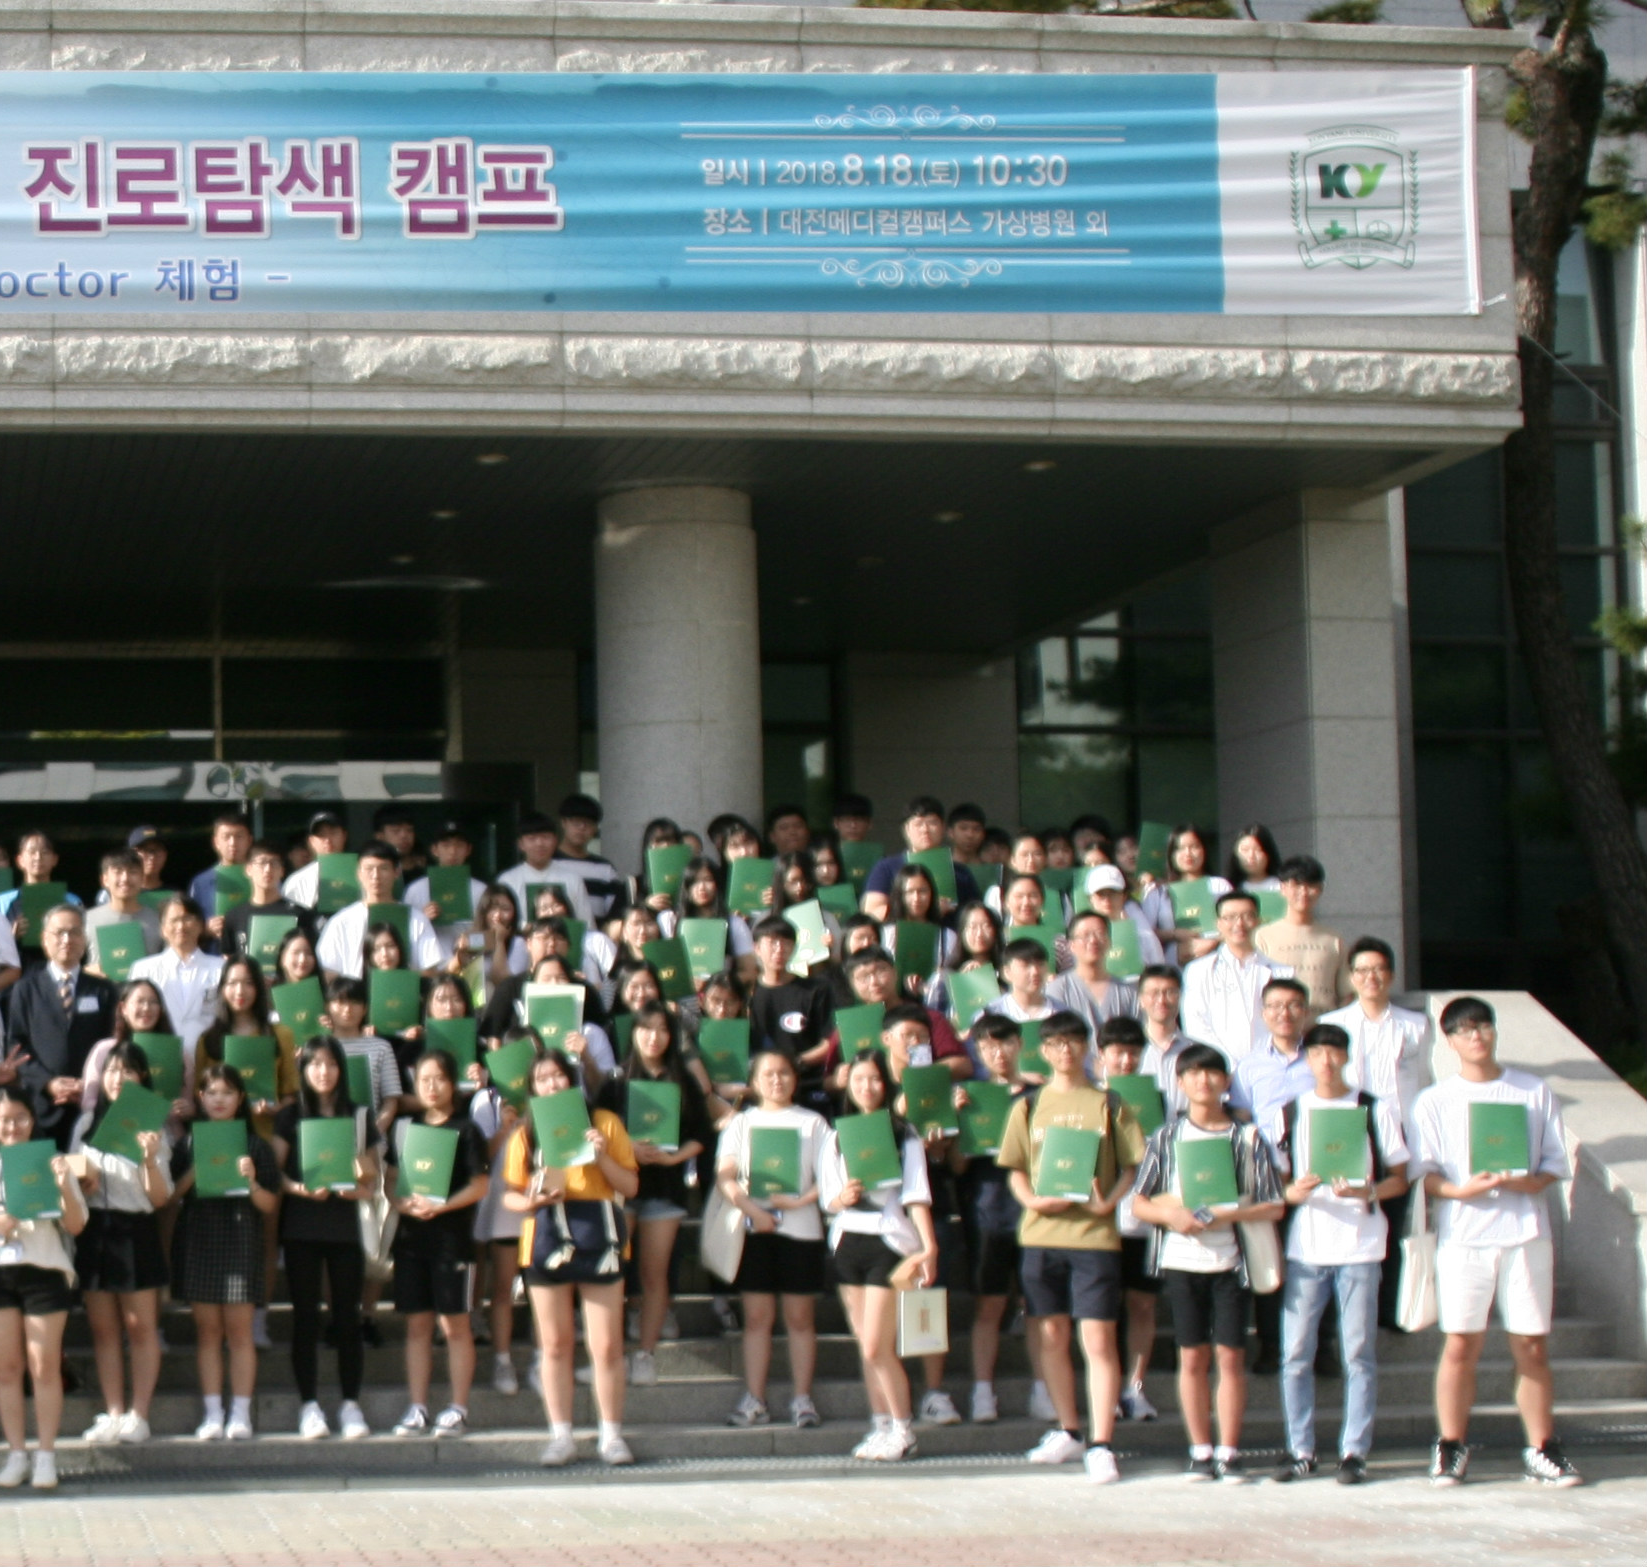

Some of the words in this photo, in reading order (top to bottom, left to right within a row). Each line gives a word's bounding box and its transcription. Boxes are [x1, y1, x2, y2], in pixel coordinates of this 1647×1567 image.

[24, 141, 354, 235] 진로탐색
[391, 140, 562, 233] 캠프
[701, 158, 749, 187] 일시
[974, 154, 1068, 187] 10:30
[702, 208, 752, 236] 장소
[779, 208, 972, 238] 대전메디컬캠퍼스
[982, 208, 1077, 238] 가상병원
[1086, 208, 1109, 237] 외
[155, 259, 241, 301] 체험
